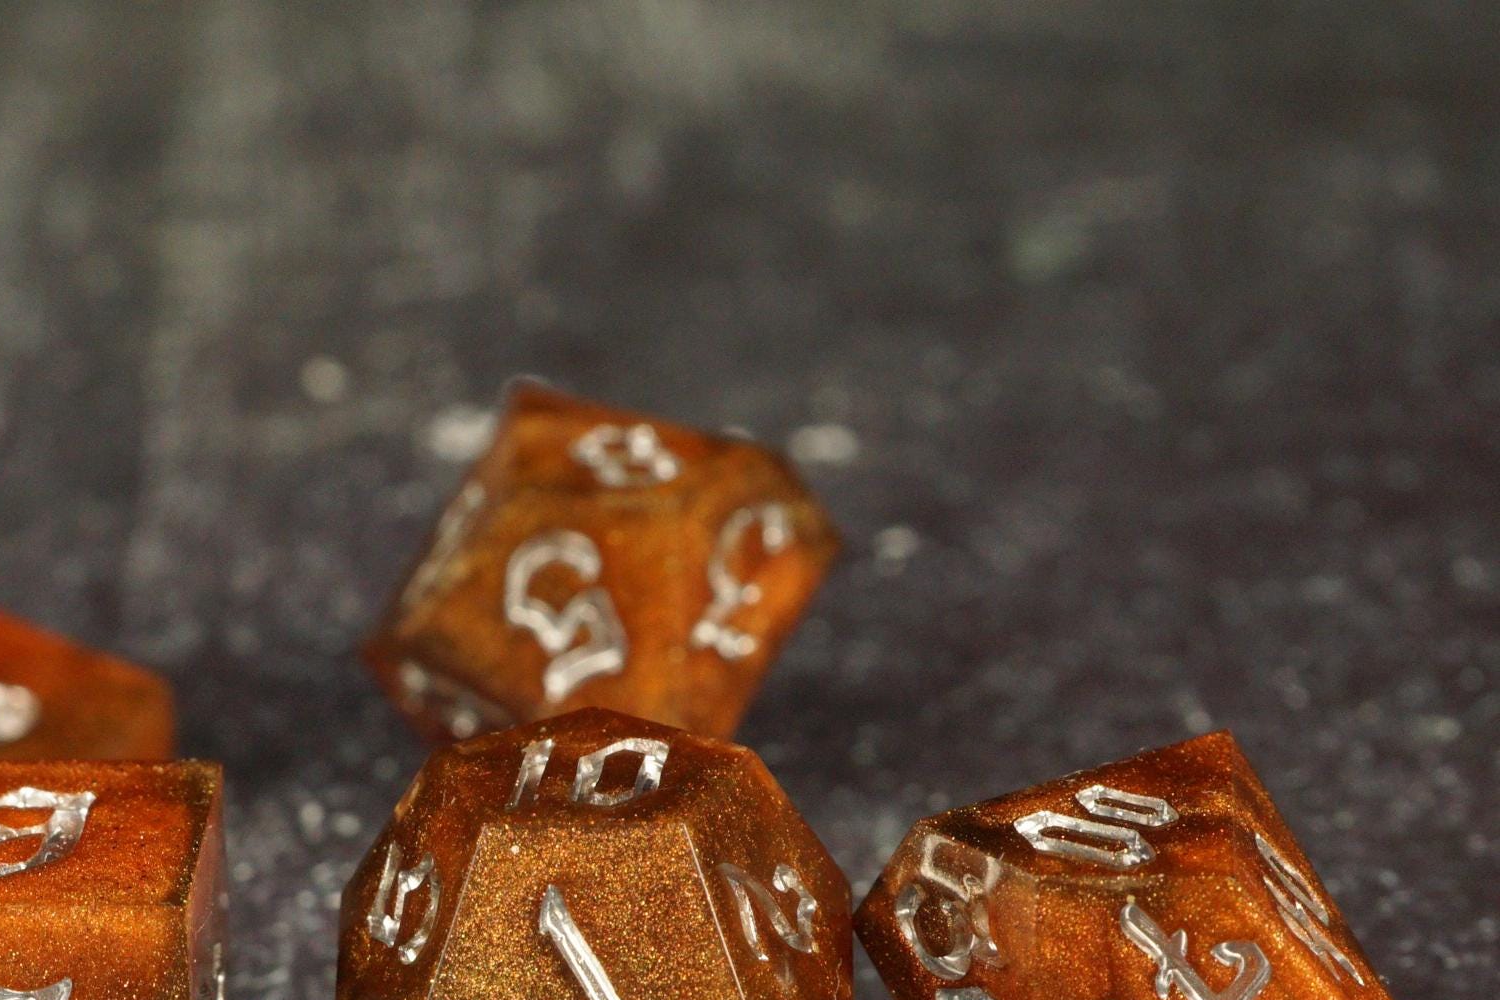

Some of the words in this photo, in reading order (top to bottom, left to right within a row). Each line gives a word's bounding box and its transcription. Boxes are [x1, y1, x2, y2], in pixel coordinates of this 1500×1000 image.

[504, 529, 628, 703] 5
[506, 737, 670, 811] 10
[1013, 784, 1179, 870] 00
